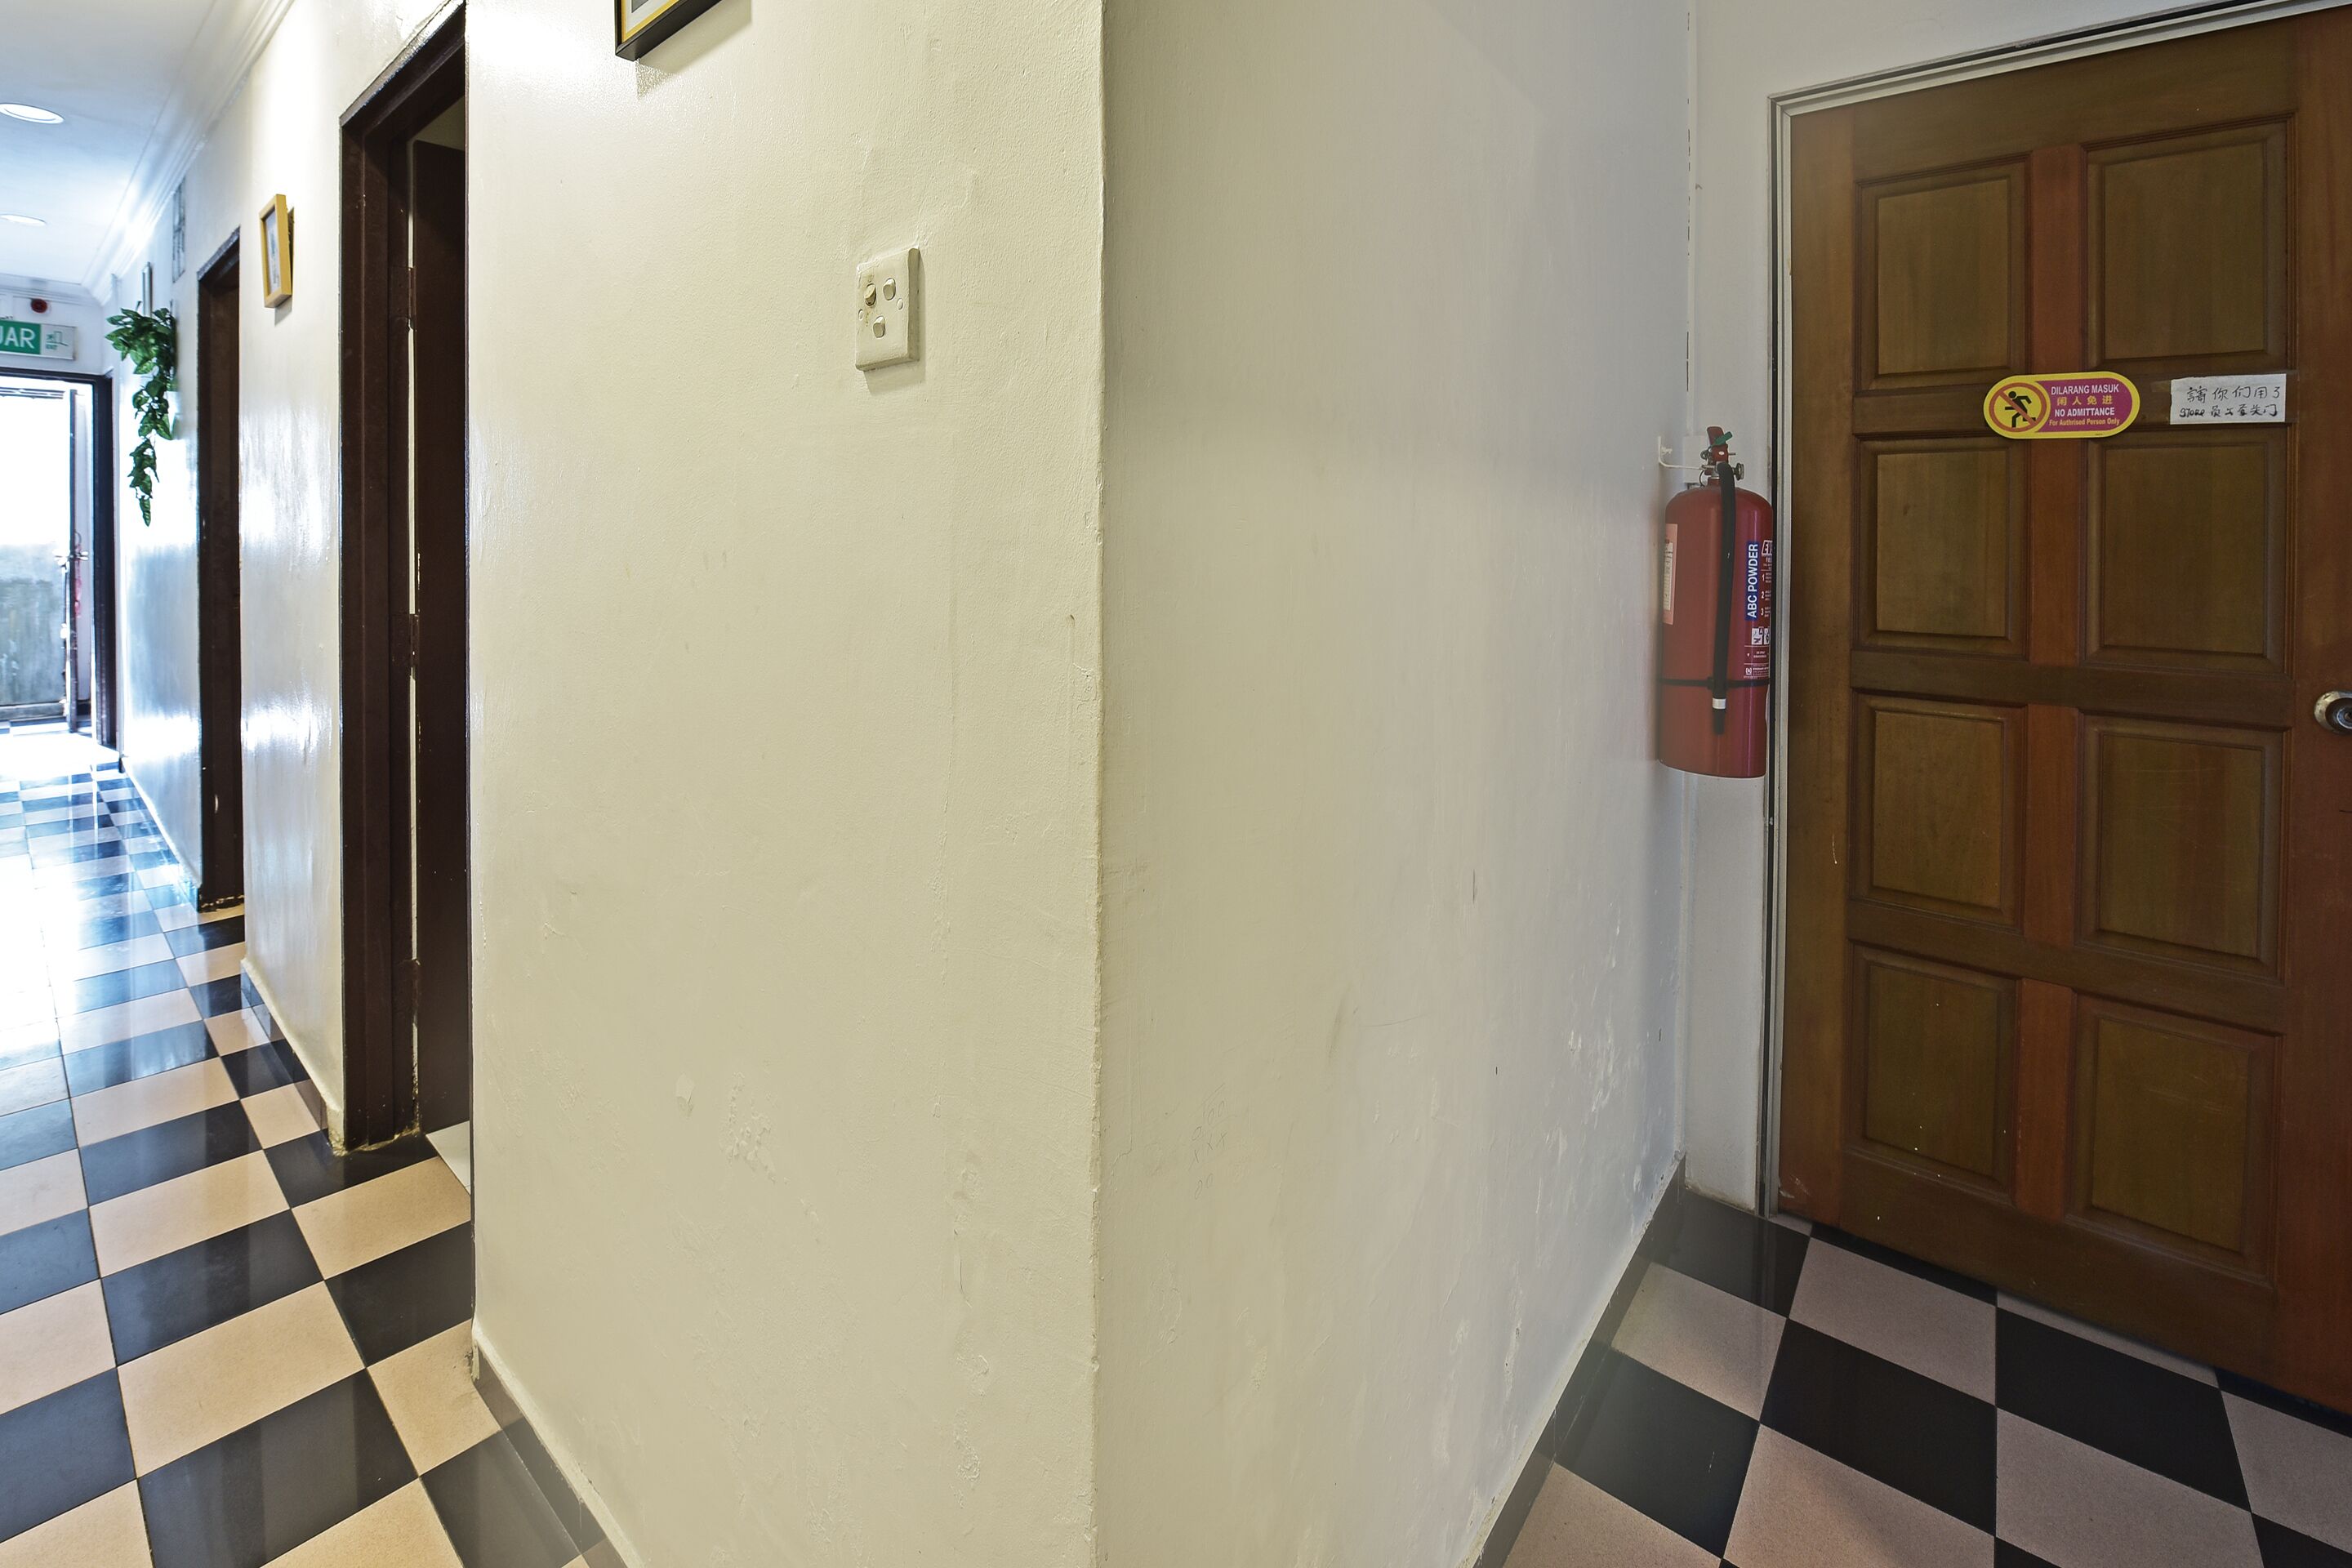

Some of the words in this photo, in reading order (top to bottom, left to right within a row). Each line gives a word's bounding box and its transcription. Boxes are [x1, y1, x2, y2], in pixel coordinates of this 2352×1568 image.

[2051, 385, 2089, 394] DILARANG
[2091, 384, 2119, 393] MASUK
[2067, 408, 2115, 416] ADMITTANCE
[2107, 417, 2120, 426] Only
[1748, 544, 1758, 592] POWDER
[1762, 590, 1765, 599] 2
[1747, 595, 1757, 618] ABC
